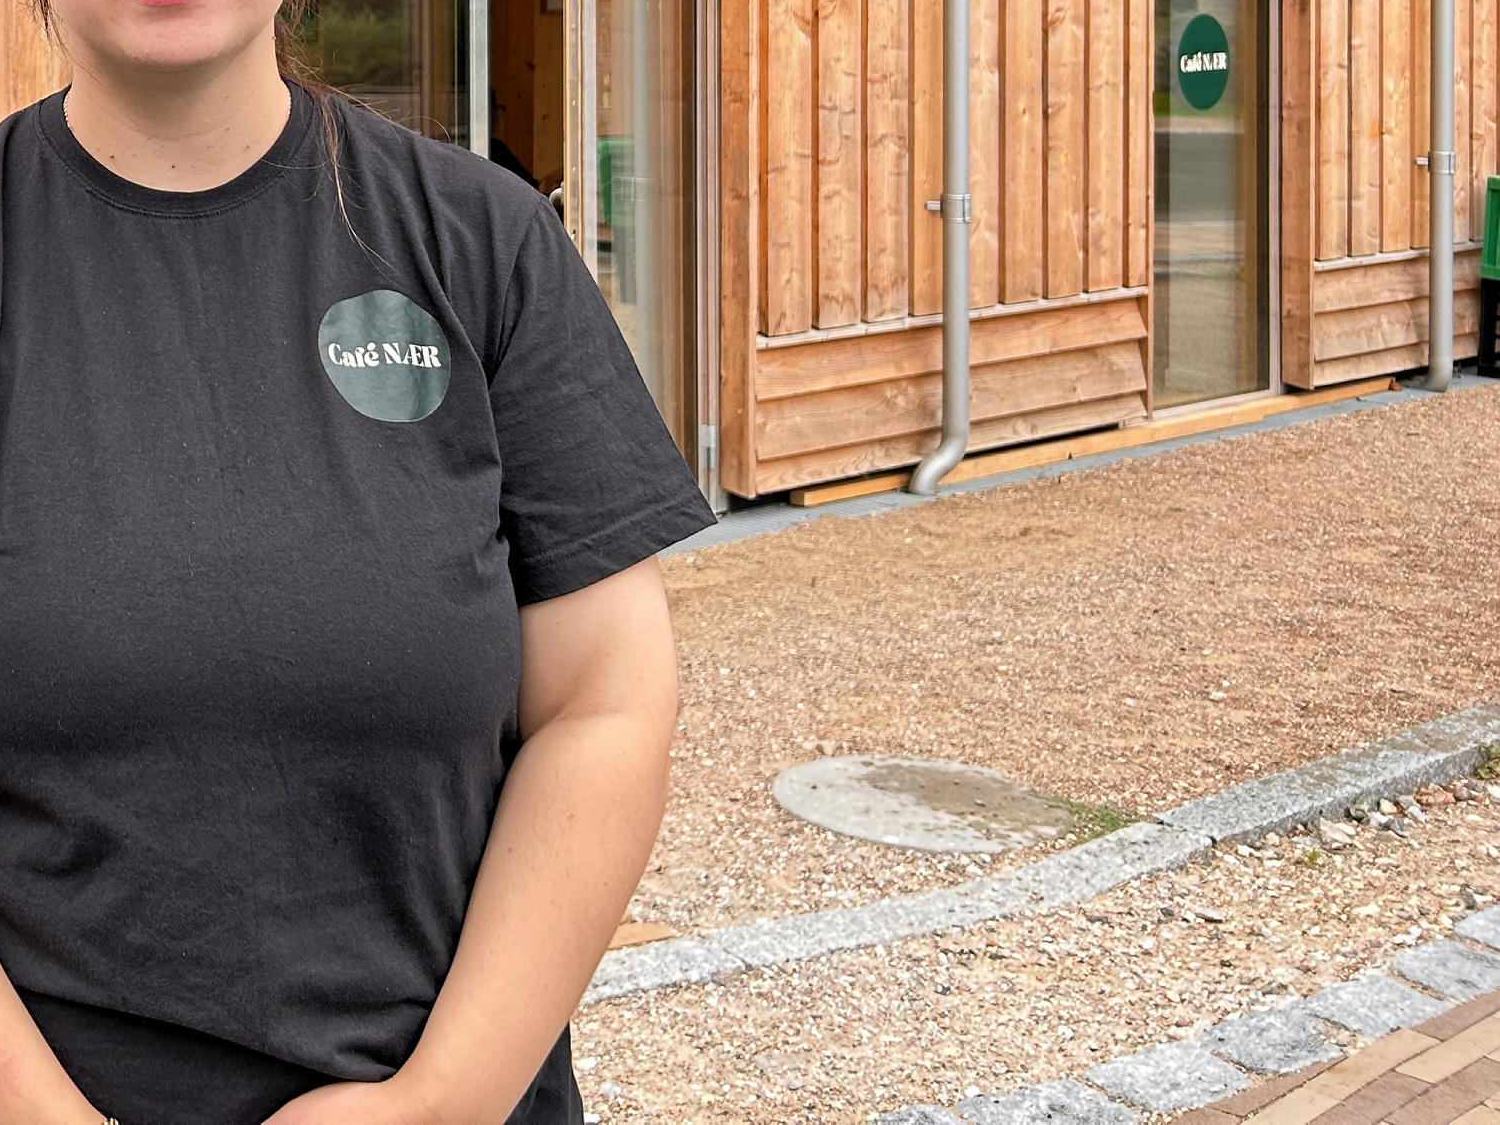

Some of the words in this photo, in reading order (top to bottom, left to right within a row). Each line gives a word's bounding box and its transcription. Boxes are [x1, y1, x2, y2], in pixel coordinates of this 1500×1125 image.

[1180, 51, 1202, 73] Café
[328, 342, 380, 368] Café
[381, 342, 442, 368] NÆR
